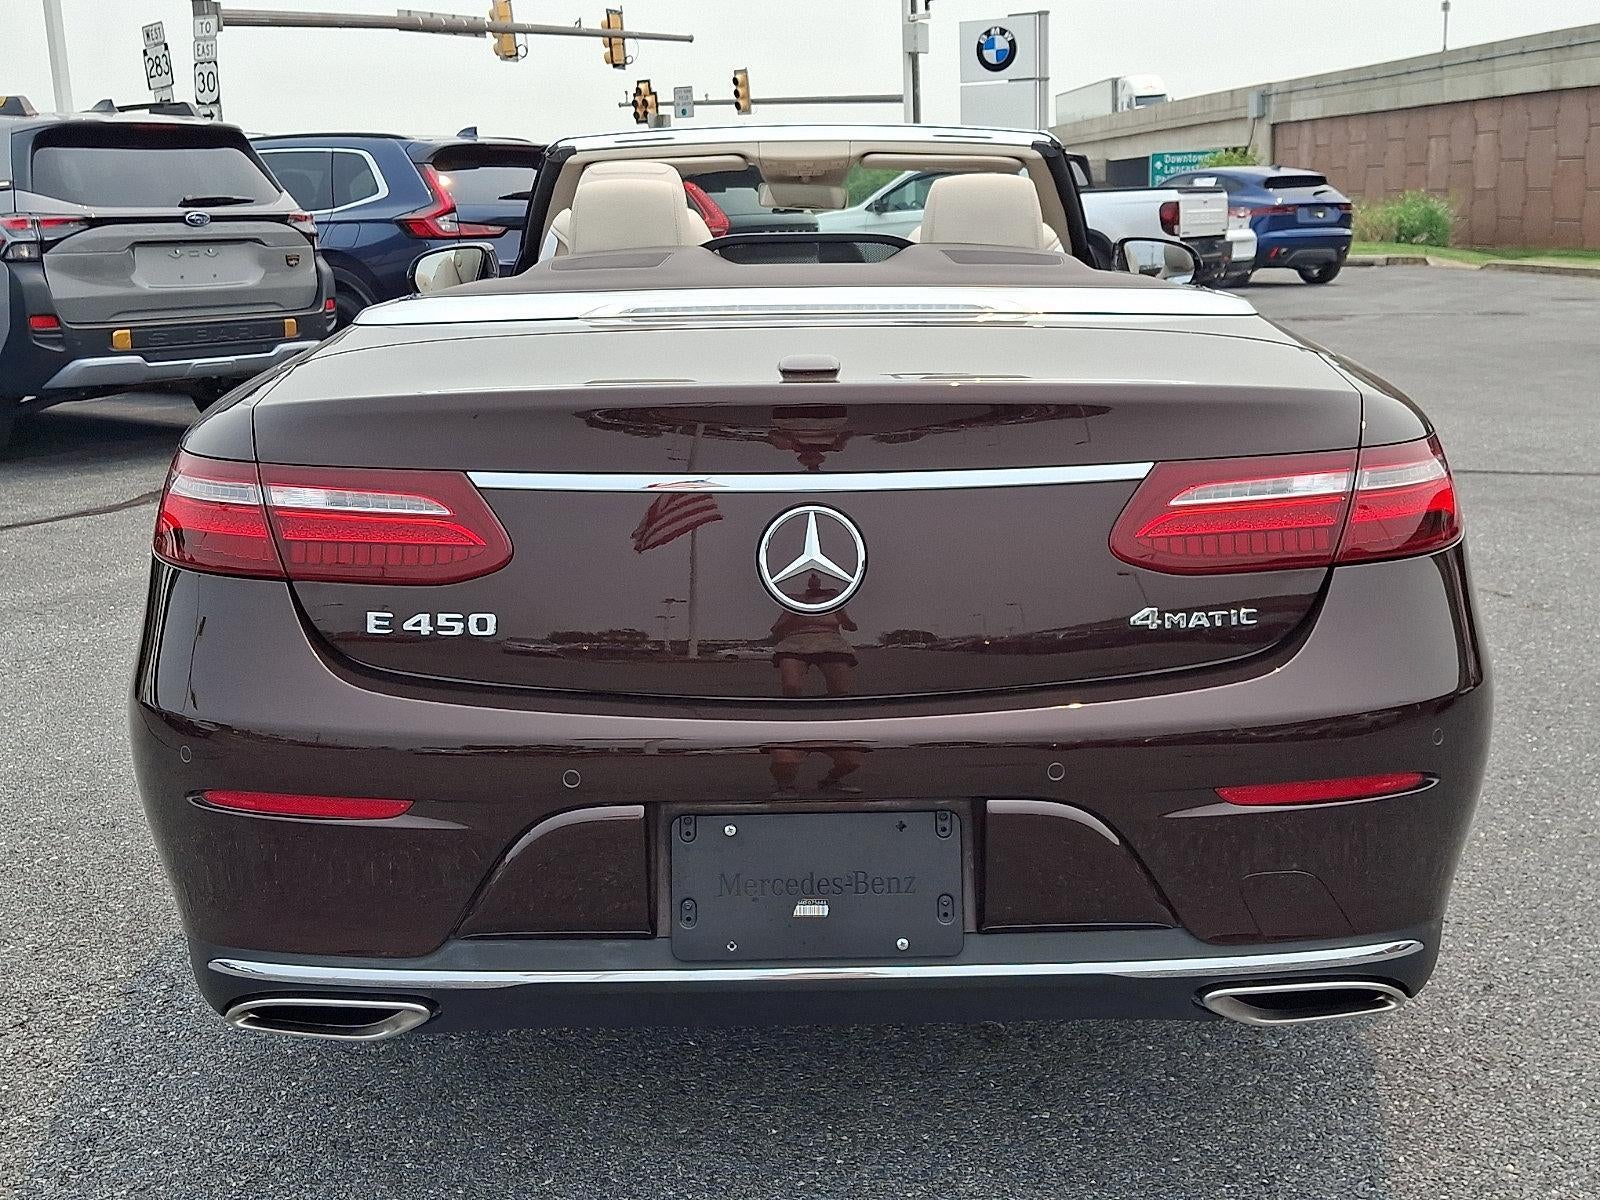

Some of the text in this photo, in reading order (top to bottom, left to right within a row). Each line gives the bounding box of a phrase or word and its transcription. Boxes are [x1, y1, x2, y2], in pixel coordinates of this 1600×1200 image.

[144, 26, 163, 42] WEST
[199, 20, 212, 34] TO
[979, 26, 1014, 45] BMW
[196, 43, 214, 57] EAST
[147, 53, 169, 78] 283
[197, 71, 216, 93] 30
[1163, 153, 1210, 164] Downtown
[366, 611, 497, 636] E 450
[1129, 606, 1258, 630] 4MATIC
[715, 870, 919, 897] Mercedes-Benz
